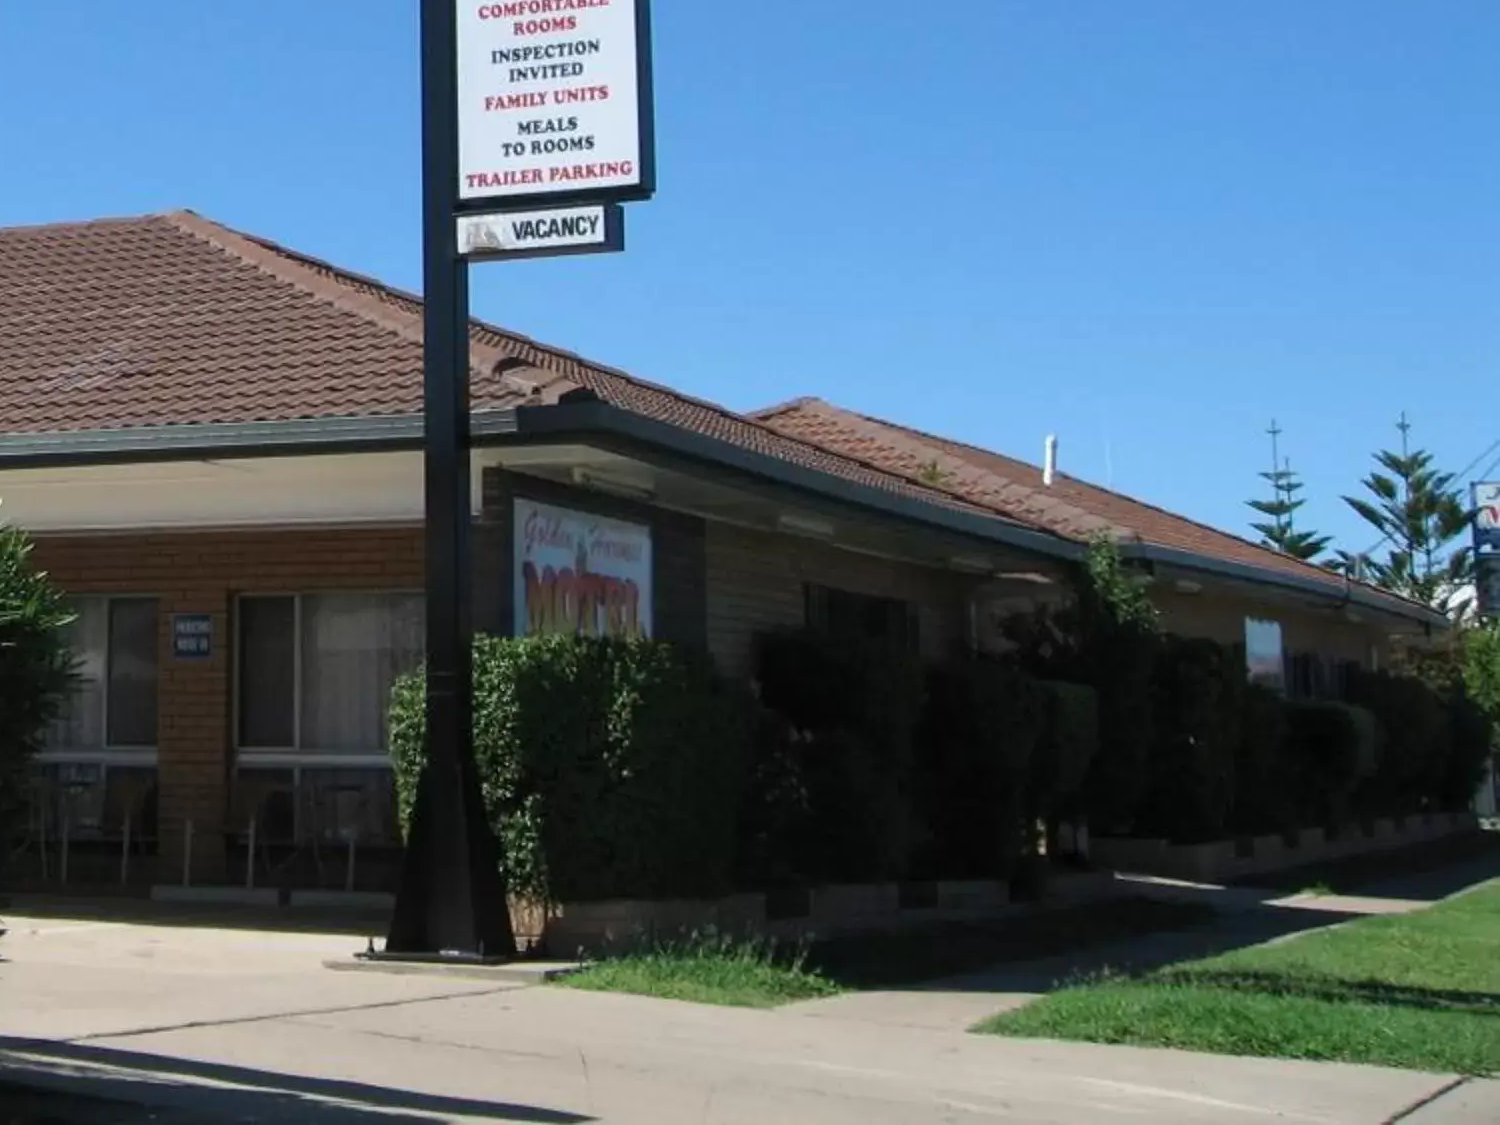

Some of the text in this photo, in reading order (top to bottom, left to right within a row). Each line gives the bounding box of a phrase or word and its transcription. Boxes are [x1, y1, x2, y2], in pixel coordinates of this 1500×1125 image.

[513, 16, 576, 35] ROOMS
[491, 39, 600, 63] INSPECTION
[509, 62, 583, 82] INVITED
[485, 85, 608, 111] FAMILY UNITS
[517, 117, 577, 135] MEALS
[502, 136, 594, 157] TO ROOMS
[466, 161, 632, 188] TRAILER PARKING
[512, 215, 599, 241] VACANCY
